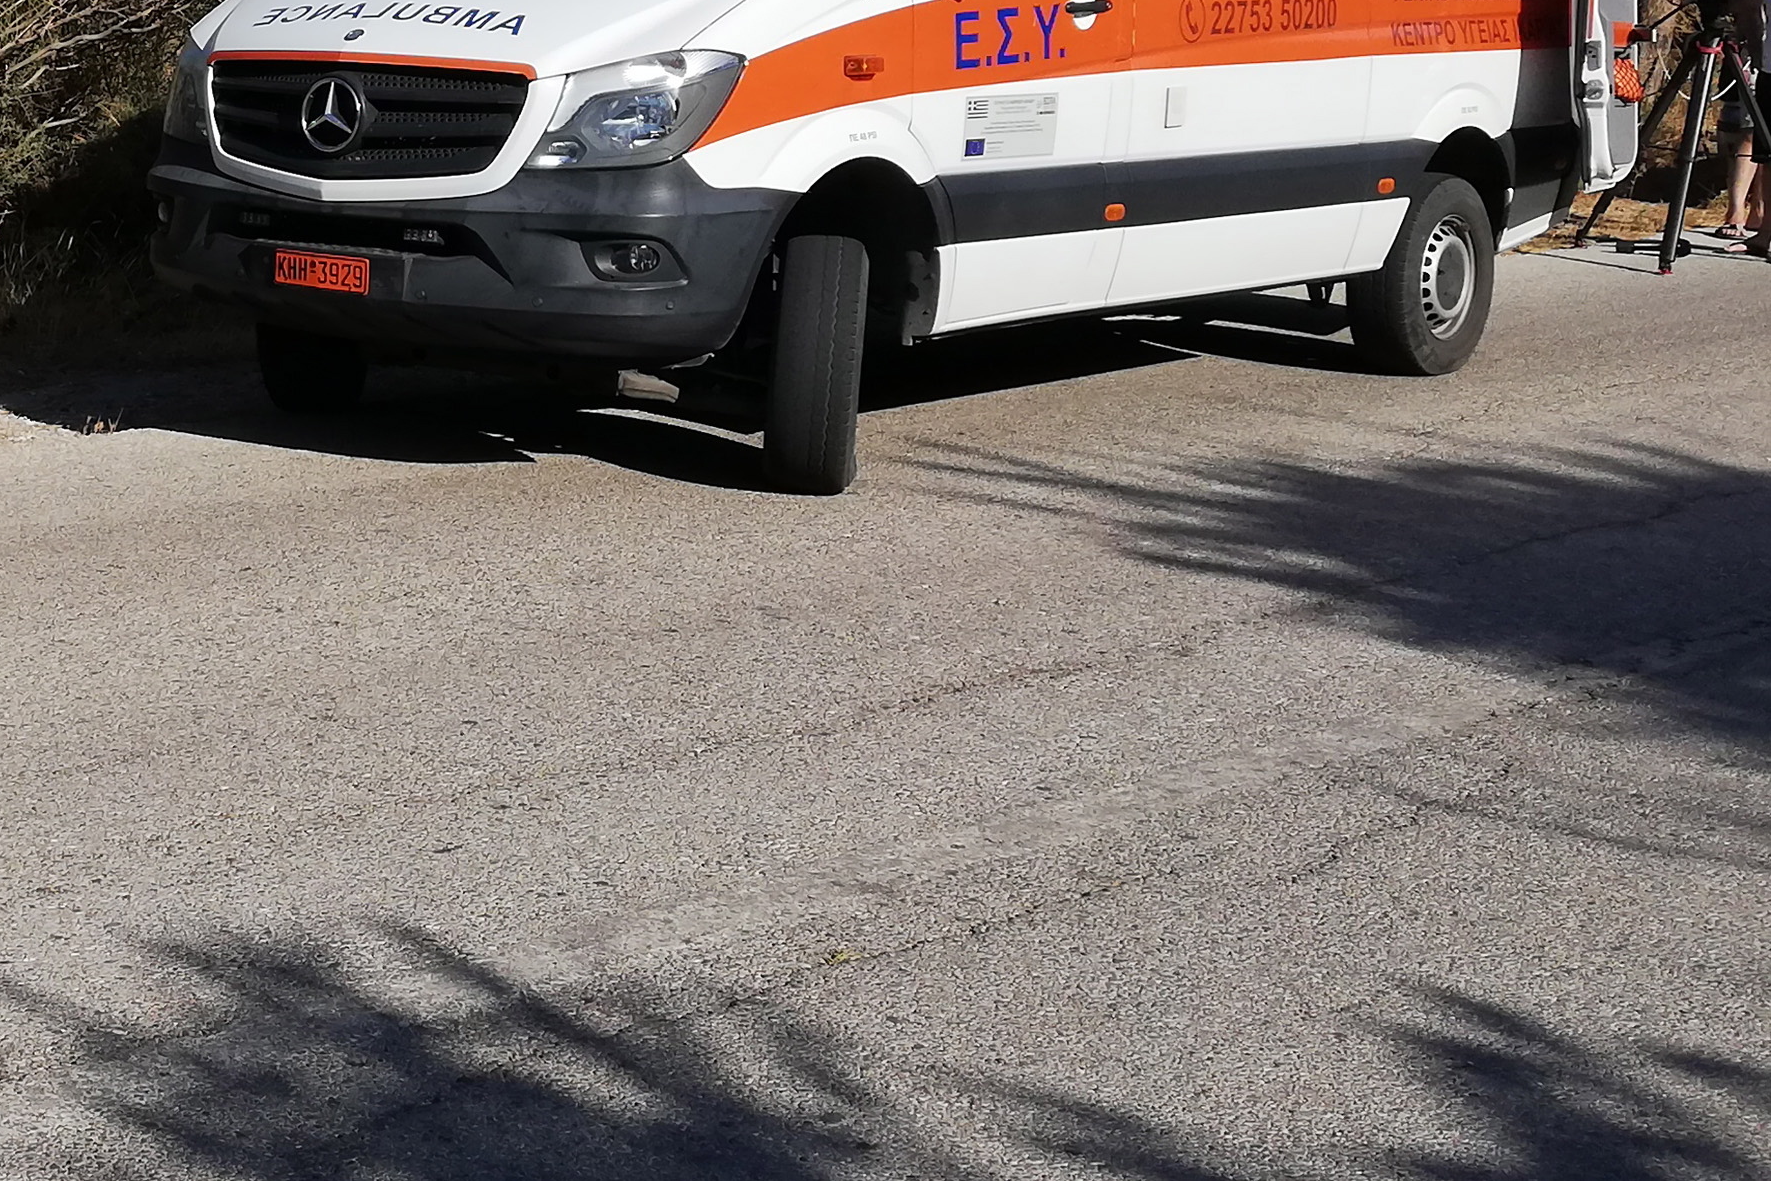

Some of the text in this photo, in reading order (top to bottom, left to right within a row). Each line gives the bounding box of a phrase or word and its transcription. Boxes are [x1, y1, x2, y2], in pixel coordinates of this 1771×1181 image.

[1210, 0, 1273, 35] 22753
[1391, 21, 1456, 47] ΚΕΝΤΡΟ
[1460, 20, 1511, 44] ΥΓΕΙΑΣ
[955, 3, 1065, 69] Ε.Σ.Υ.
